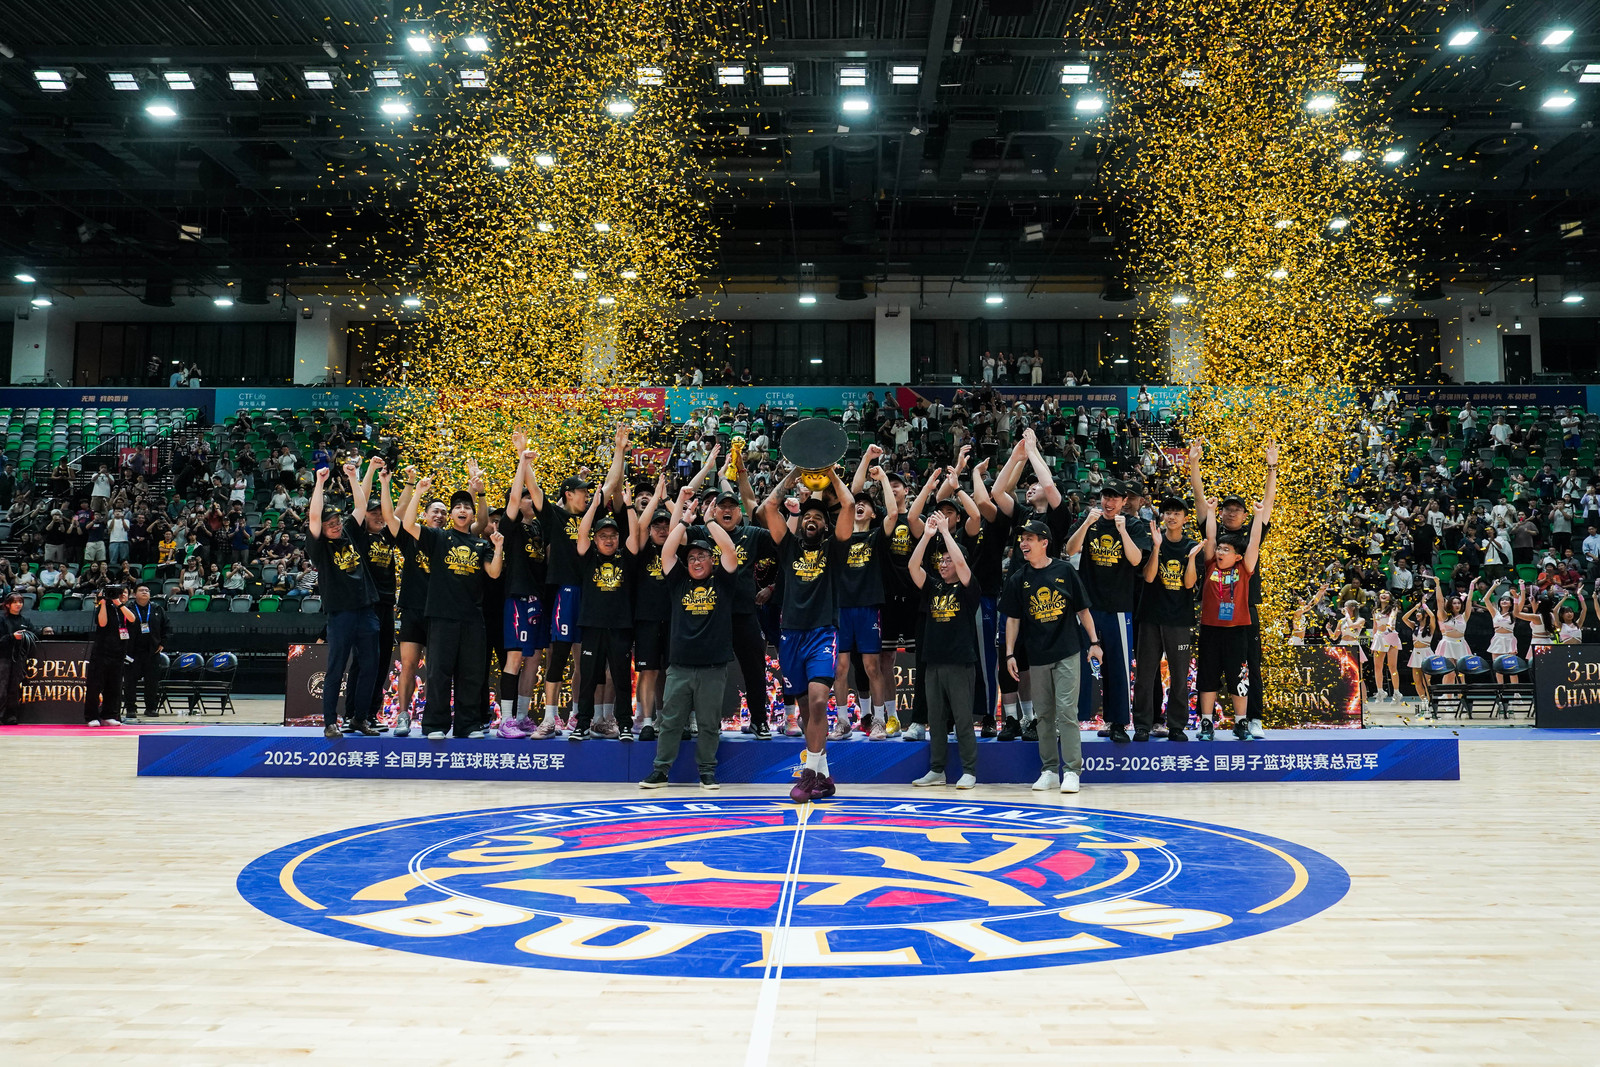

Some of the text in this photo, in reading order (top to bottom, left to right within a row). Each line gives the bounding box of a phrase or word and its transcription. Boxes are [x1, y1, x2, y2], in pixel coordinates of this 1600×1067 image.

[1038, 599, 1067, 615] CHAMPION
[520, 630, 528, 642] 0
[561, 624, 569, 636] 9
[25, 658, 90, 679] 3-PEAT
[1567, 660, 1600, 683] 3-P
[264, 751, 566, 770] 2025-2026赛季 全国男子篮球联赛总冠军
[1080, 753, 1379, 772] 2025-2026赛季全 国男子篮球联赛总冠军
[514, 803, 1089, 825] HONG KONG
[326, 897, 1234, 968] BULLS
